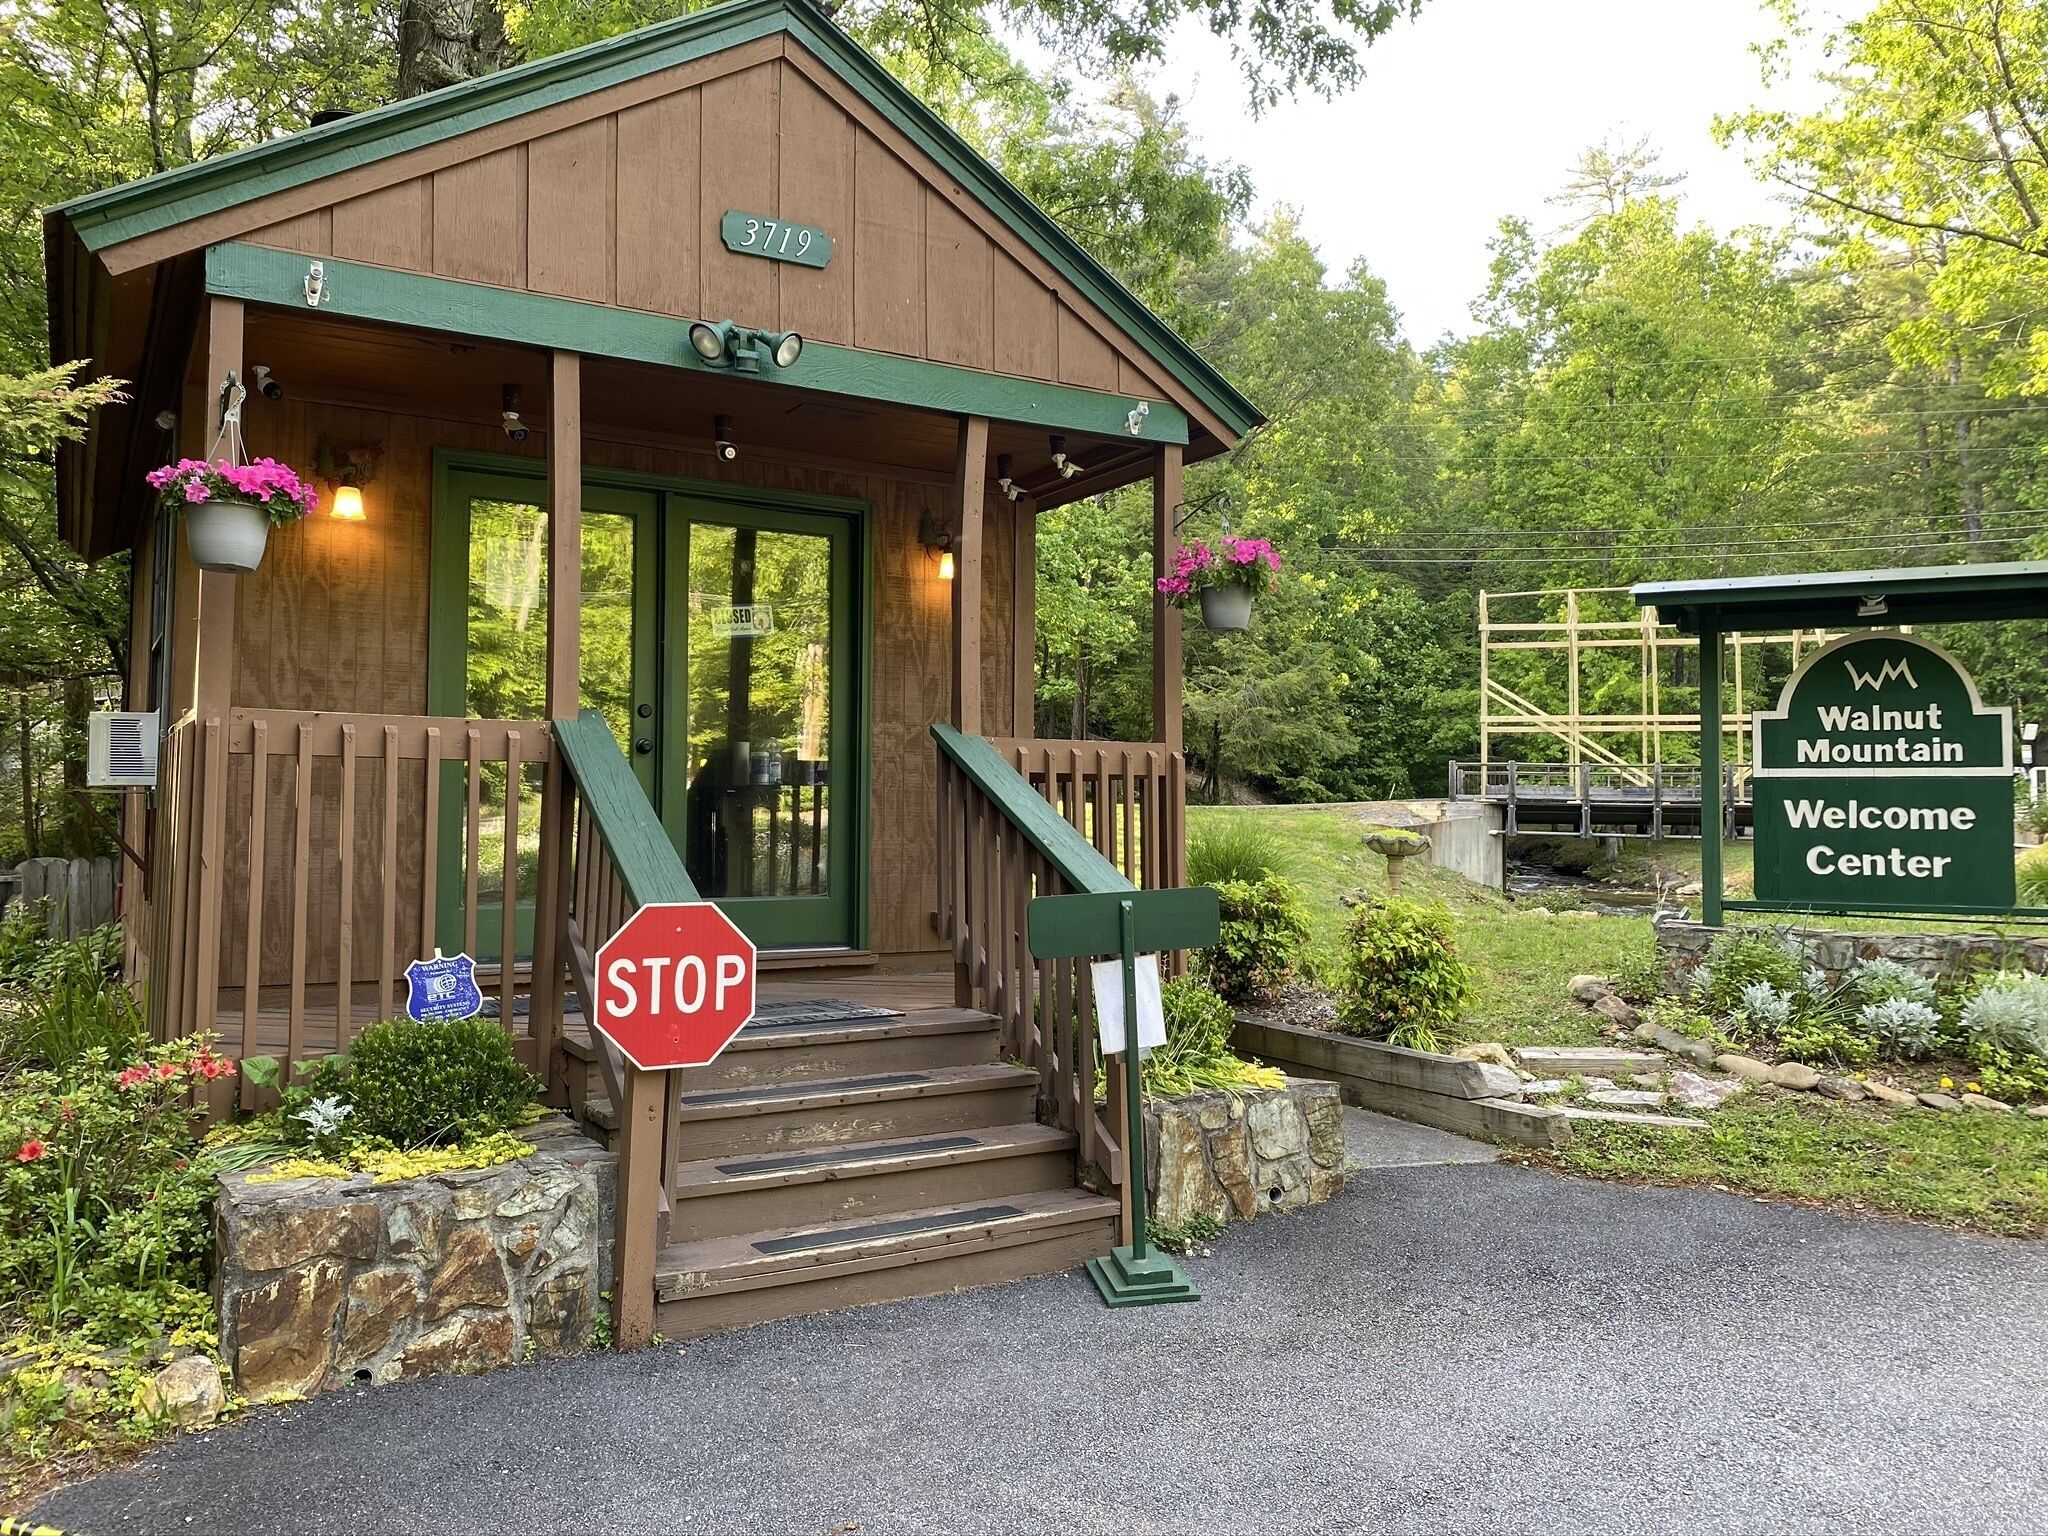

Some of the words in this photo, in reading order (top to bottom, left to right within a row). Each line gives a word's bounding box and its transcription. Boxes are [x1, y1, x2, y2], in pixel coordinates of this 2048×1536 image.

[740, 219, 811, 257] 3719
[1817, 703, 1942, 732] Walnut
[1797, 737, 1964, 763] Mountain
[1783, 799, 1976, 830] Welcome
[1806, 845, 1952, 878] Center
[421, 961, 458, 972] WARNING
[605, 954, 746, 1018] STOP
[420, 1004, 446, 1012] SECURITY
